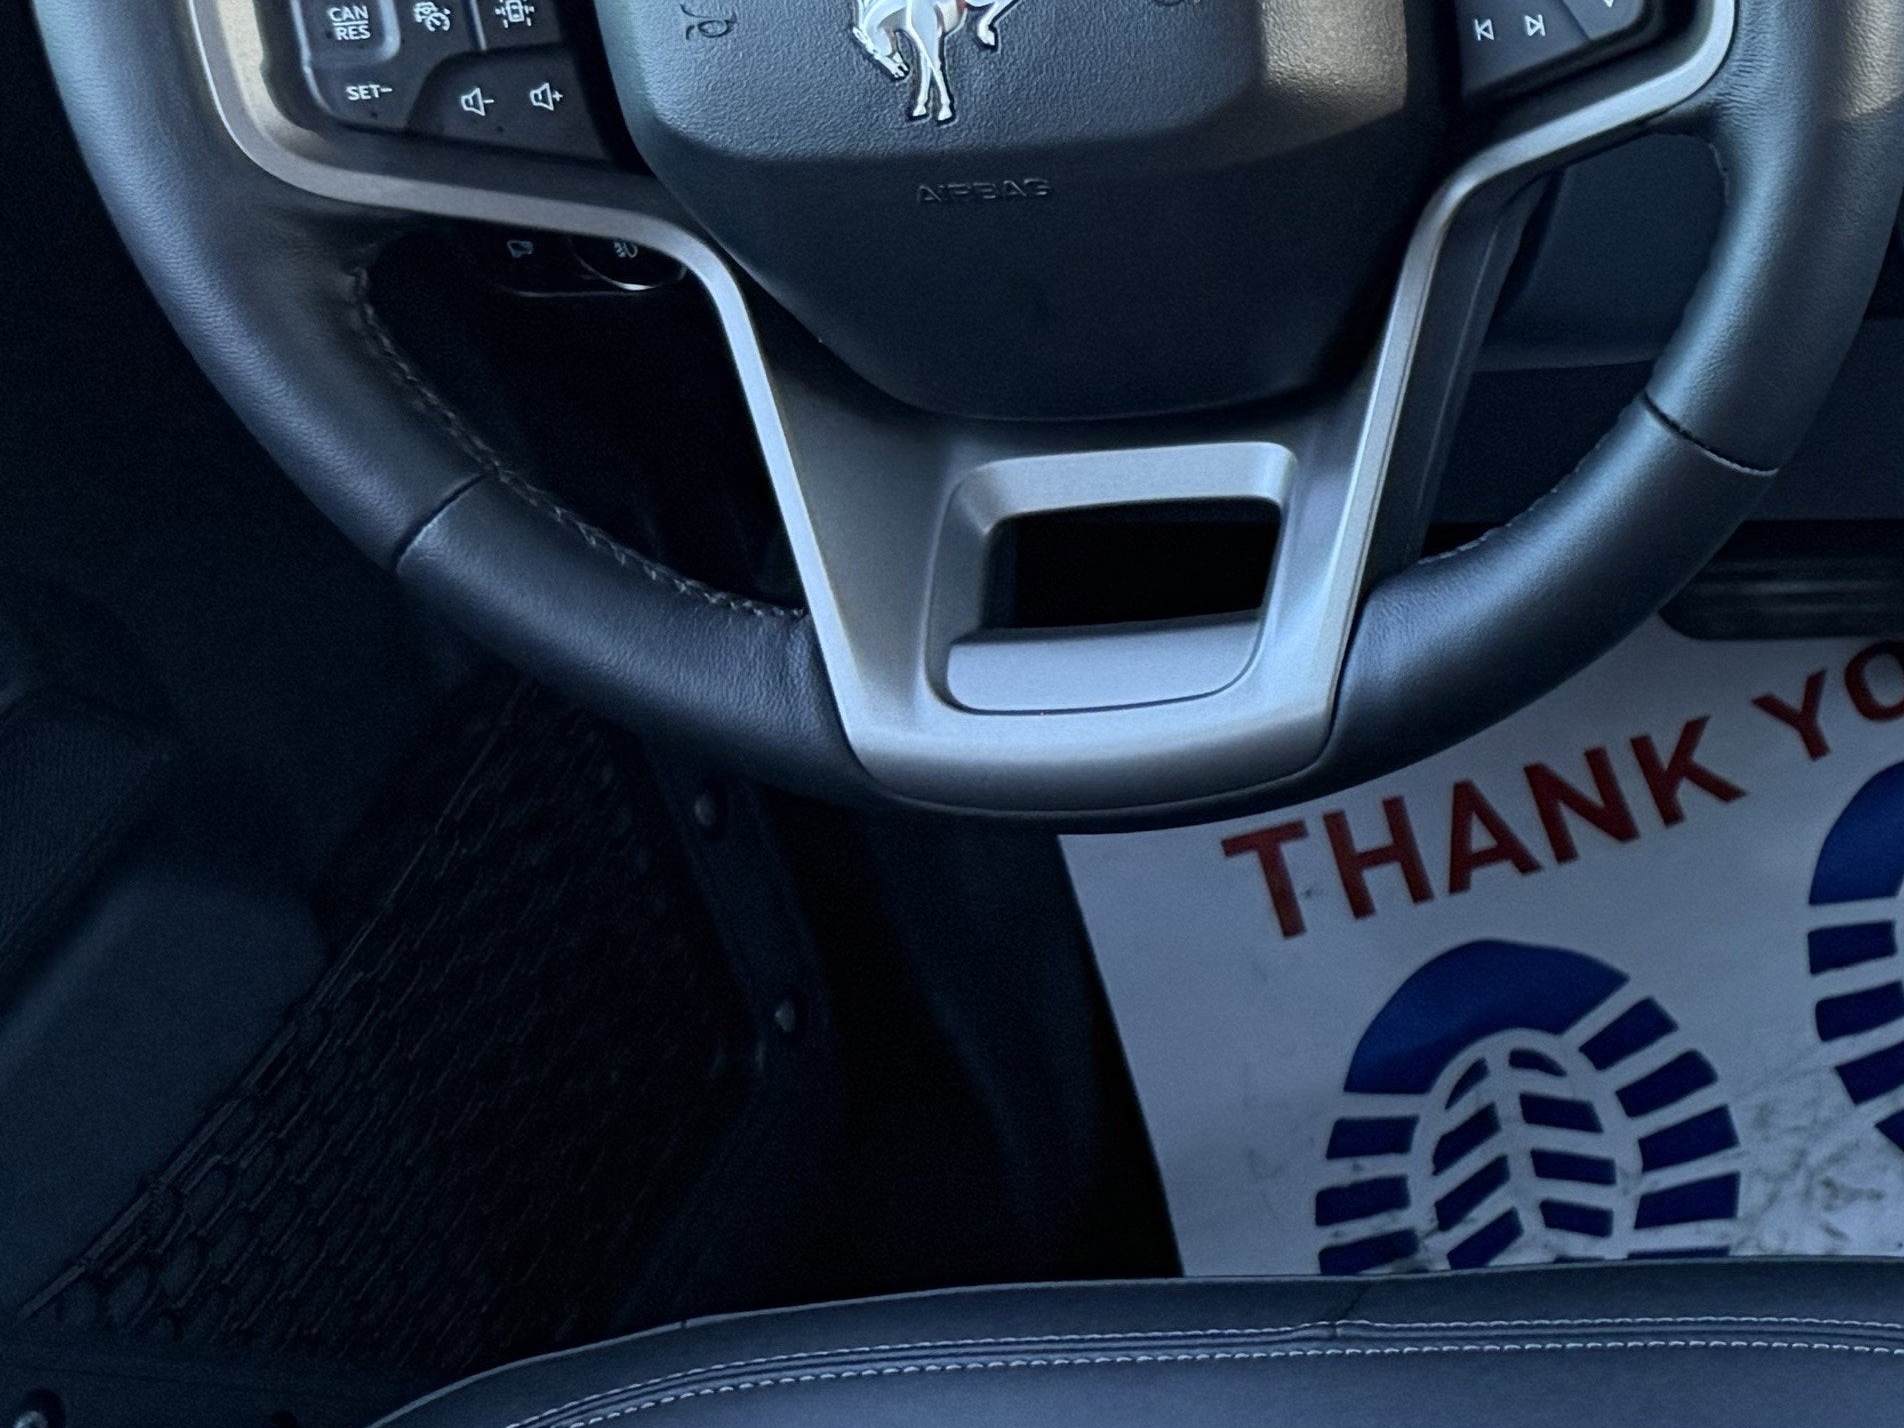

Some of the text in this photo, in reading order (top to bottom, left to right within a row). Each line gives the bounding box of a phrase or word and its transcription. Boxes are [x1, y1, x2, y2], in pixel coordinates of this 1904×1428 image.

[328, 7, 369, 27] CAN
[335, 22, 371, 41] RES
[1221, 715, 1750, 941] THANK
